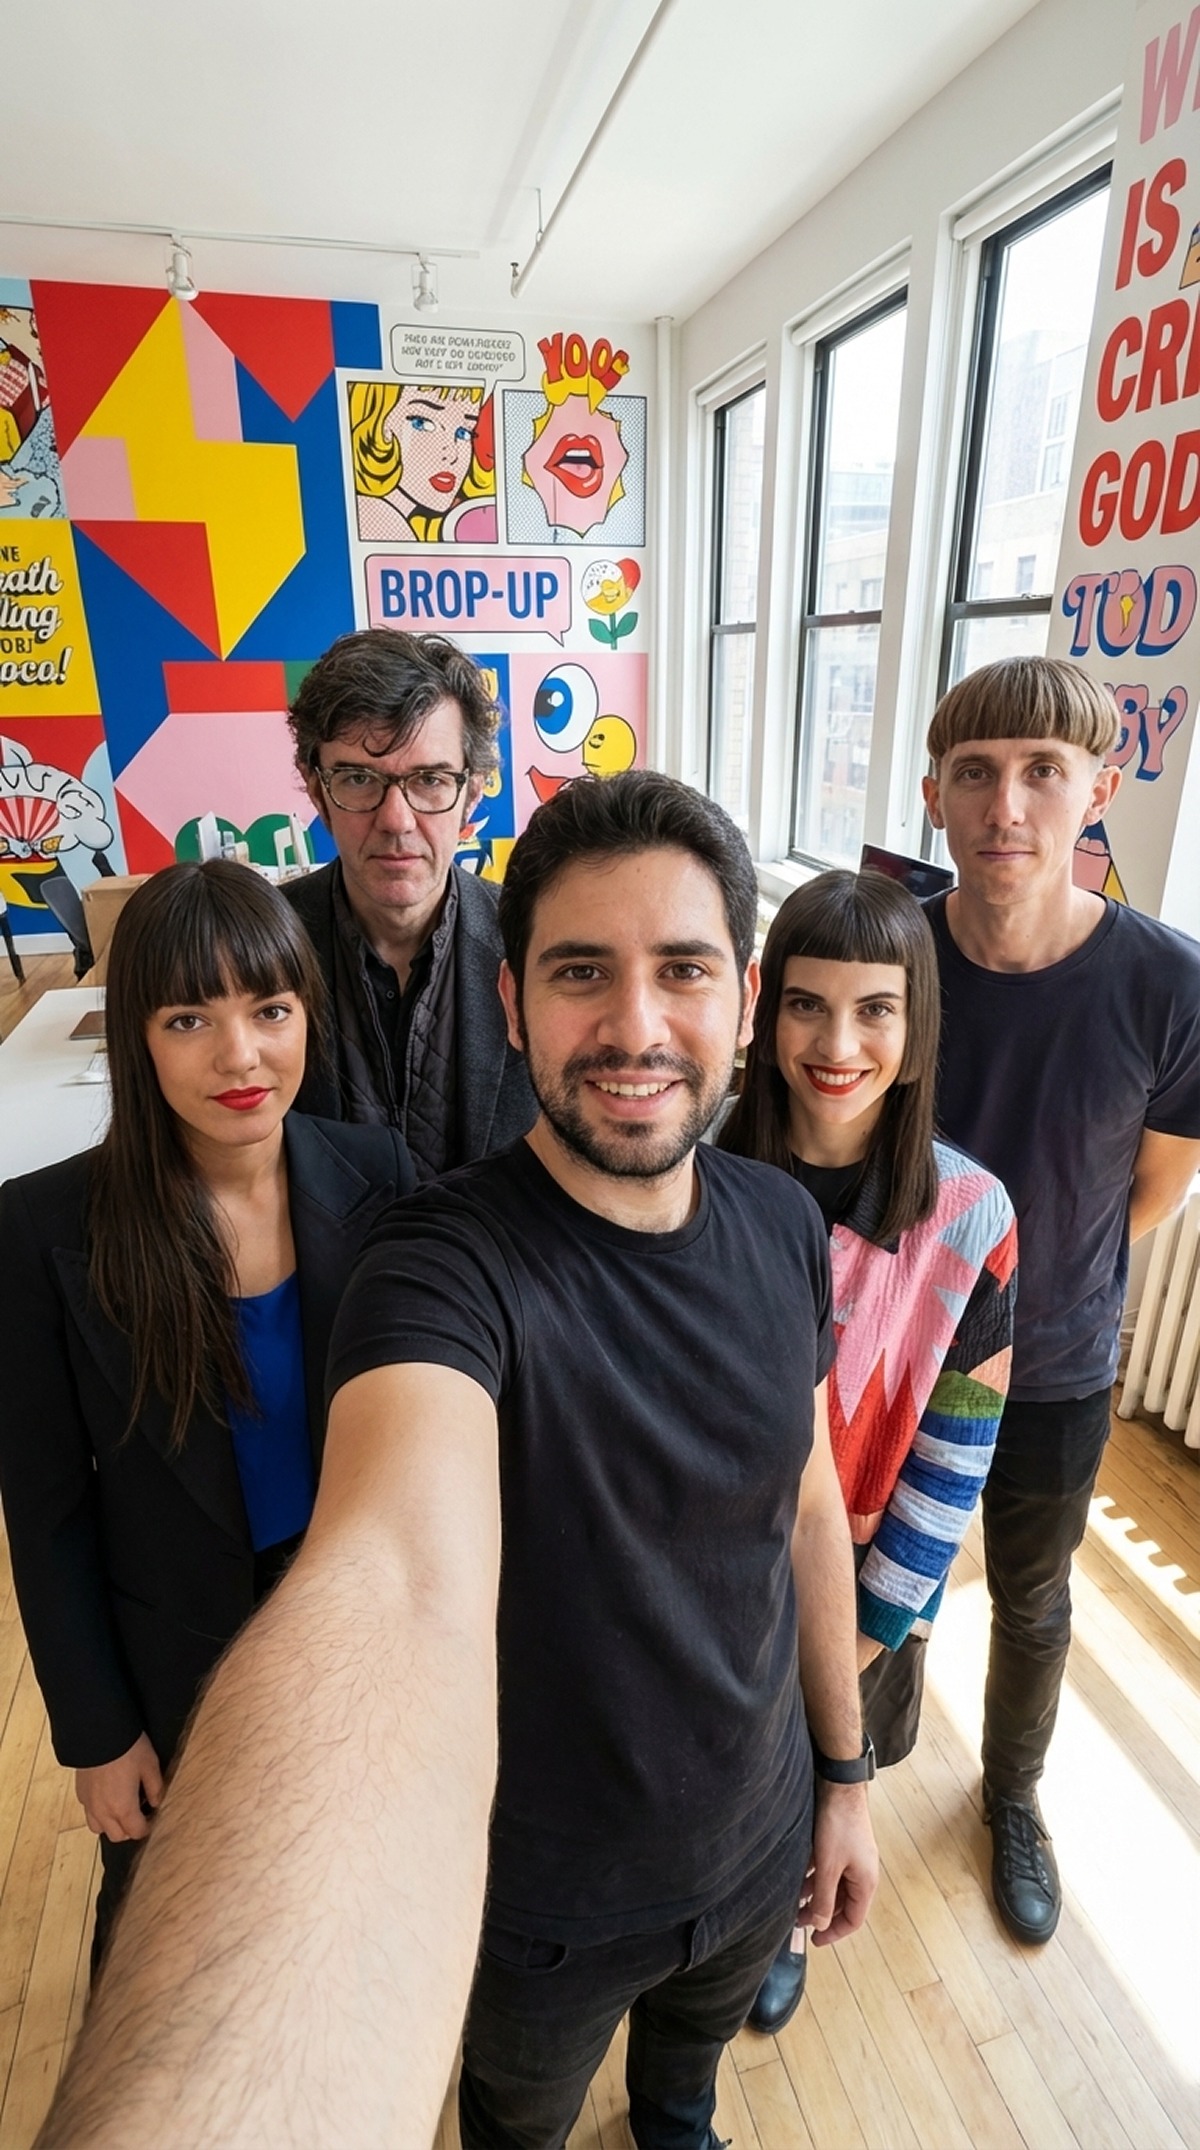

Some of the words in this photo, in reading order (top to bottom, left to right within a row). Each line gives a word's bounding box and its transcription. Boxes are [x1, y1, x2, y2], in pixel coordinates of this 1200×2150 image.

[1139, 3, 1200, 145] W
[1115, 158, 1186, 291] IS
[1079, 428, 1200, 547] GOD
[0, 597, 63, 644] ling
[380, 569, 559, 619] BROP-UP
[1062, 565, 1197, 657] TOD
